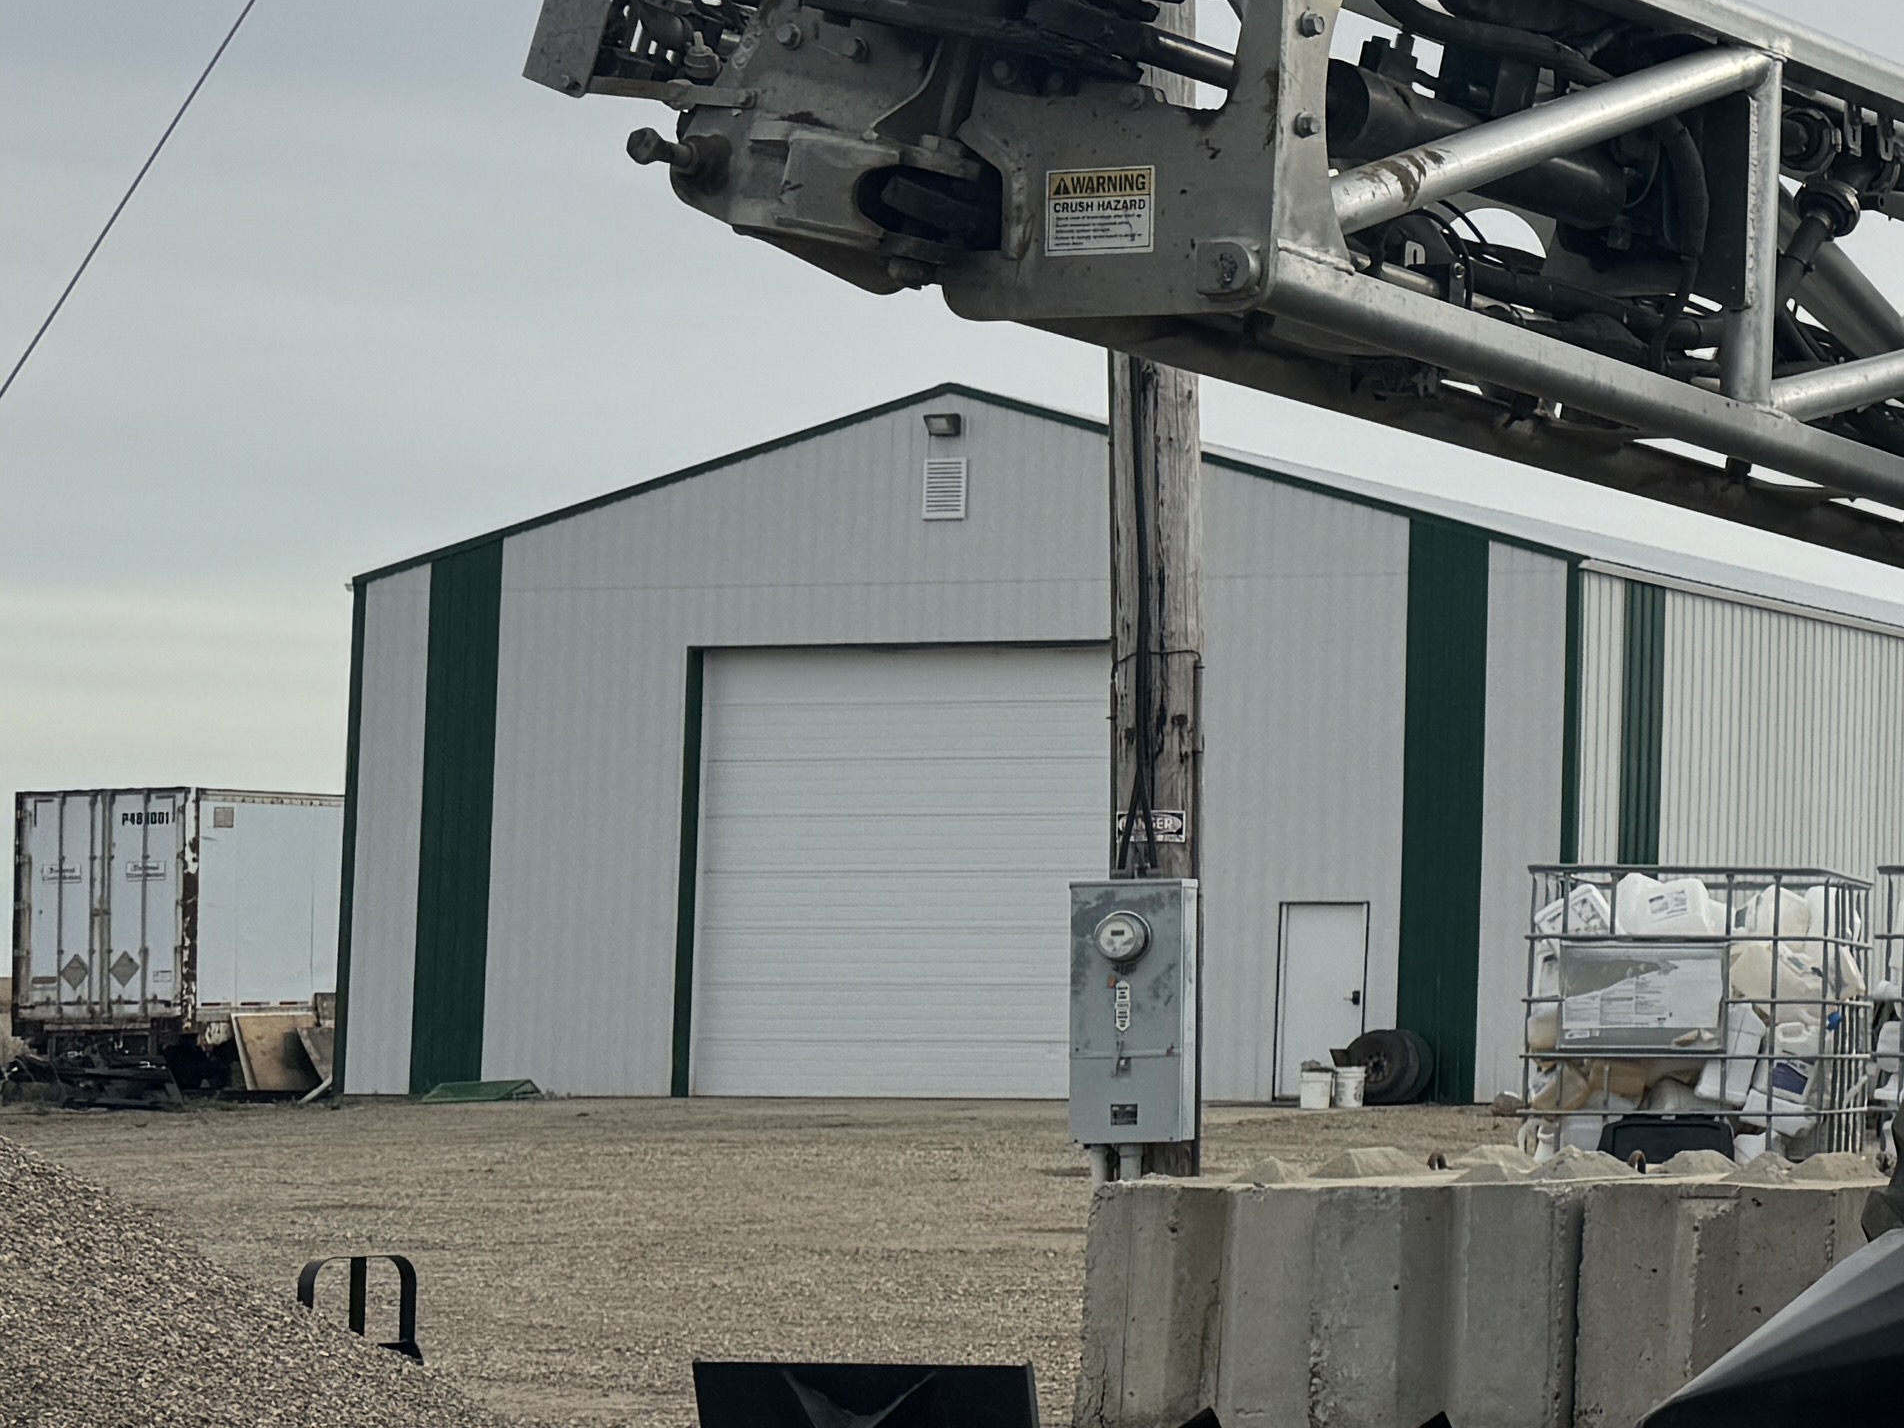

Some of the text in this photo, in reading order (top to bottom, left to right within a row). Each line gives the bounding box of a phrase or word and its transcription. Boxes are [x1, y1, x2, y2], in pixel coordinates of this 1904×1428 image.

[1071, 173, 1146, 195] WARNING
[1053, 198, 1146, 214] CRUSH HAZARD
